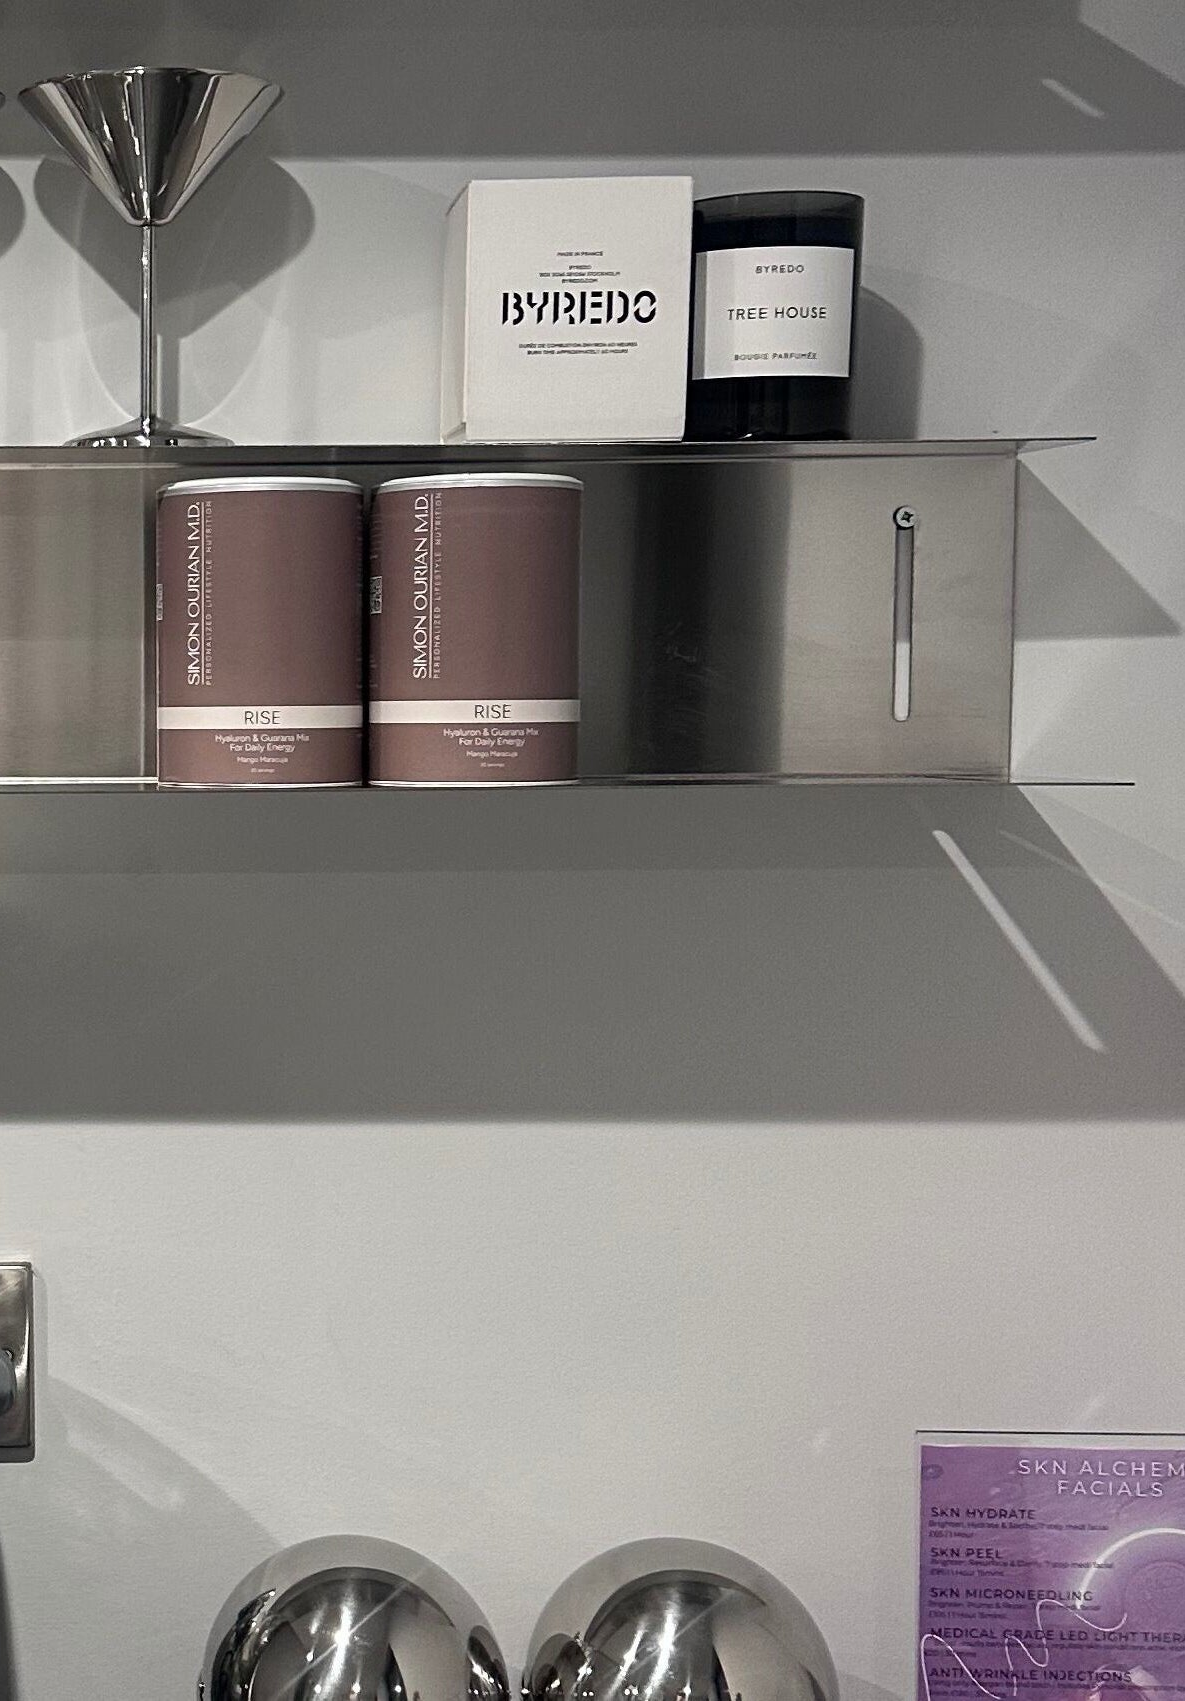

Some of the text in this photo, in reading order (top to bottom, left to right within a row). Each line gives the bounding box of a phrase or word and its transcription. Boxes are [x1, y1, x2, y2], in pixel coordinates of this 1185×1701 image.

[755, 264, 805, 274] BYREDO
[502, 290, 657, 326] BYREDO
[727, 306, 827, 321] TREE HOUSE
[413, 493, 429, 679] SIMON OURIAN M.D.
[433, 492, 443, 679] PERSONALIZED LIFESTYLE NUTRITION
[187, 501, 201, 686] SIMON OURIAN M.D.
[244, 710, 281, 725] RISE
[474, 704, 512, 719] RISE
[215, 734, 251, 744] Hyaluron
[253, 734, 259, 742] &
[260, 734, 295, 742] Guarana
[443, 728, 539, 738] Hyaluron & Guarana Mix
[229, 742, 296, 753] For Daily Energy
[458, 737, 526, 748] For Daily Energy
[237, 756, 259, 764] Mango
[466, 751, 489, 759] Mango
[1017, 1459, 1185, 1477] SKN ALCHEM
[1057, 1480, 1164, 1497] FACIALS
[931, 1507, 1036, 1520] SKN HYDRATE
[930, 1547, 1004, 1559] SKN PEEL
[930, 1587, 1094, 1601] SKN MICRONEEDLING
[930, 1627, 1185, 1643] MEDICAL GRADE LED LIGHT THER
[972, 1669, 1038, 1680] WRINKLE
[1043, 1670, 1132, 1683] INJECTIONS
